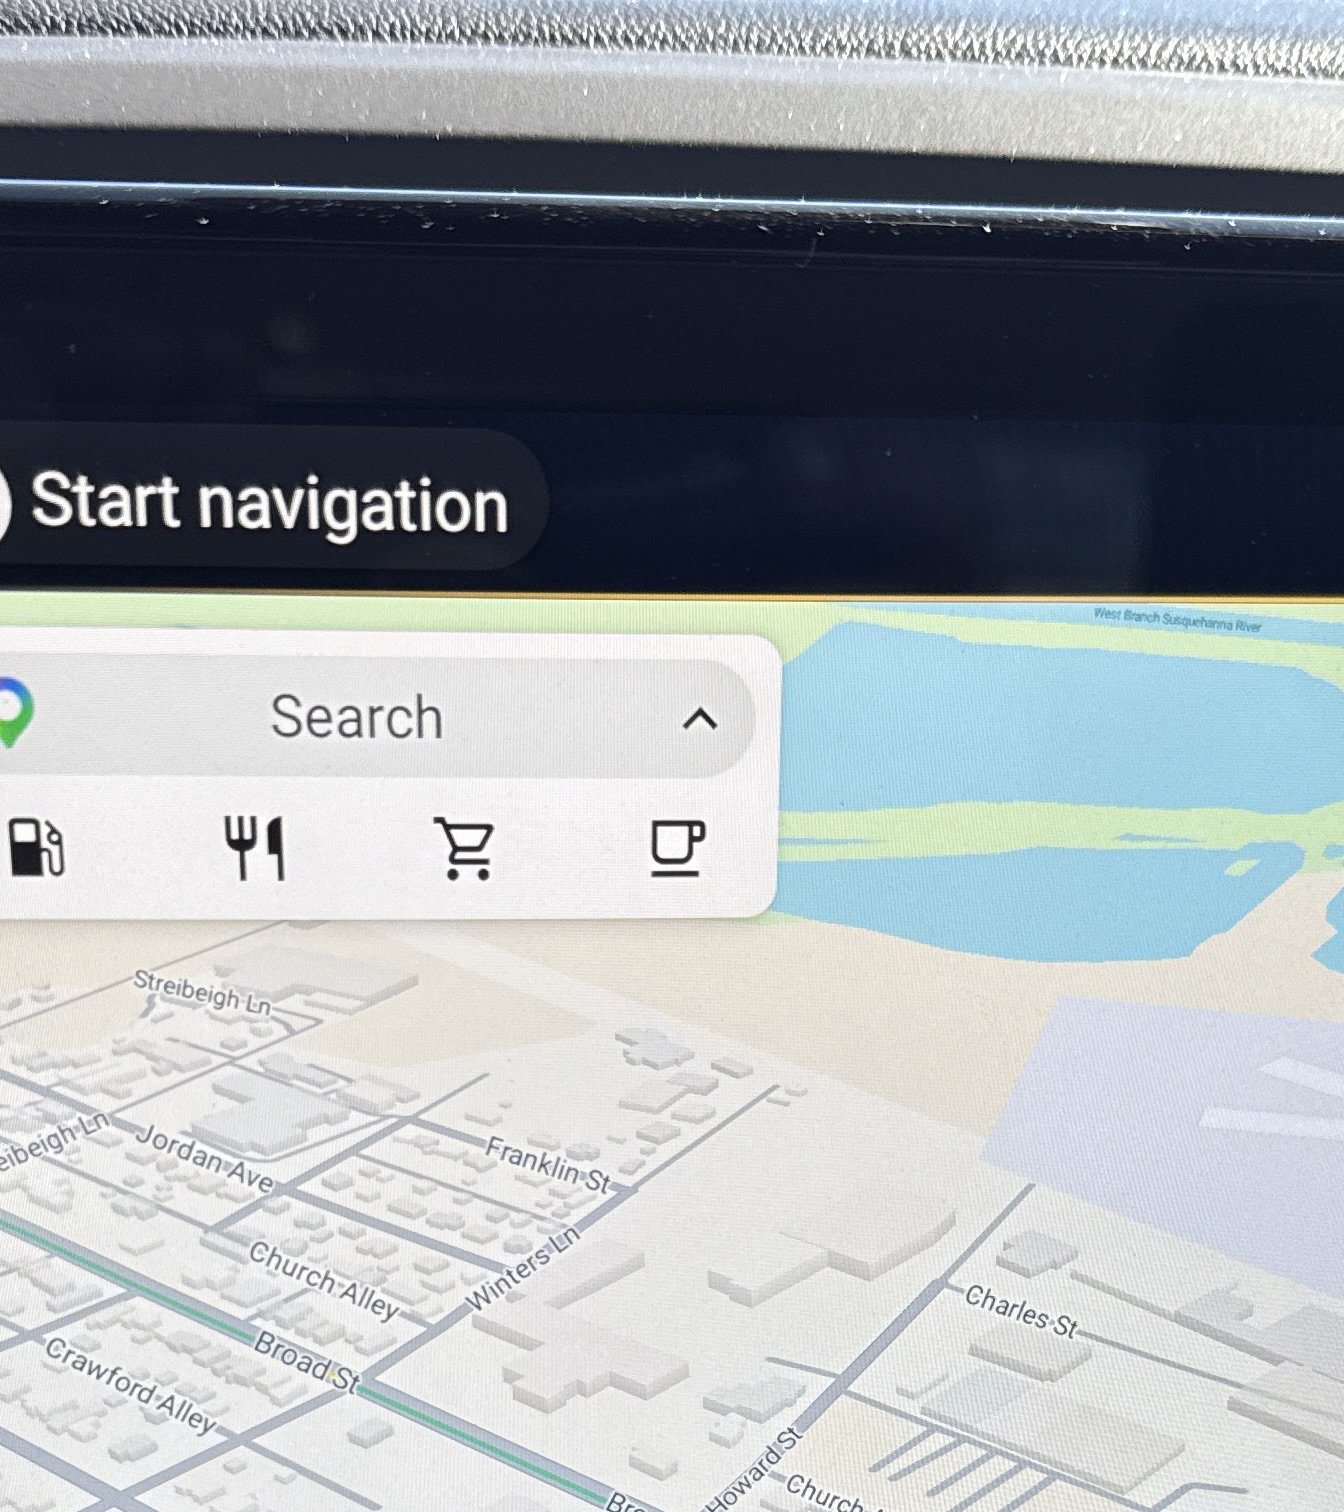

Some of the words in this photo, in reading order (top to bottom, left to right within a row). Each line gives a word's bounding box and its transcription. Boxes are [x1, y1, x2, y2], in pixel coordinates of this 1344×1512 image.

[31, 470, 179, 529] Start
[199, 473, 509, 546] navigation
[1094, 607, 1121, 620] West
[1123, 609, 1160, 623] Branch
[1162, 613, 1233, 630] Susquehanna
[1235, 620, 1262, 632] River
[271, 693, 444, 741] Search
[134, 968, 240, 1013] Streibeigh
[241, 993, 272, 1017] Ln
[72, 1110, 110, 1138] Ln
[135, 1125, 221, 1172] Jordan
[227, 1159, 274, 1194] Ave
[485, 1137, 581, 1184] Franklin
[584, 1167, 611, 1195] St
[248, 1240, 337, 1297] Church
[340, 1278, 401, 1325] Alley
[465, 1250, 551, 1312] Winters
[551, 1226, 580, 1254] Ln
[965, 1285, 1049, 1330] Charles
[1052, 1313, 1079, 1340] St
[46, 1336, 157, 1405] Crawford
[156, 1393, 218, 1438] Alley
[255, 1330, 332, 1382] Broad
[332, 1367, 361, 1396] St
[777, 1426, 804, 1453] St
